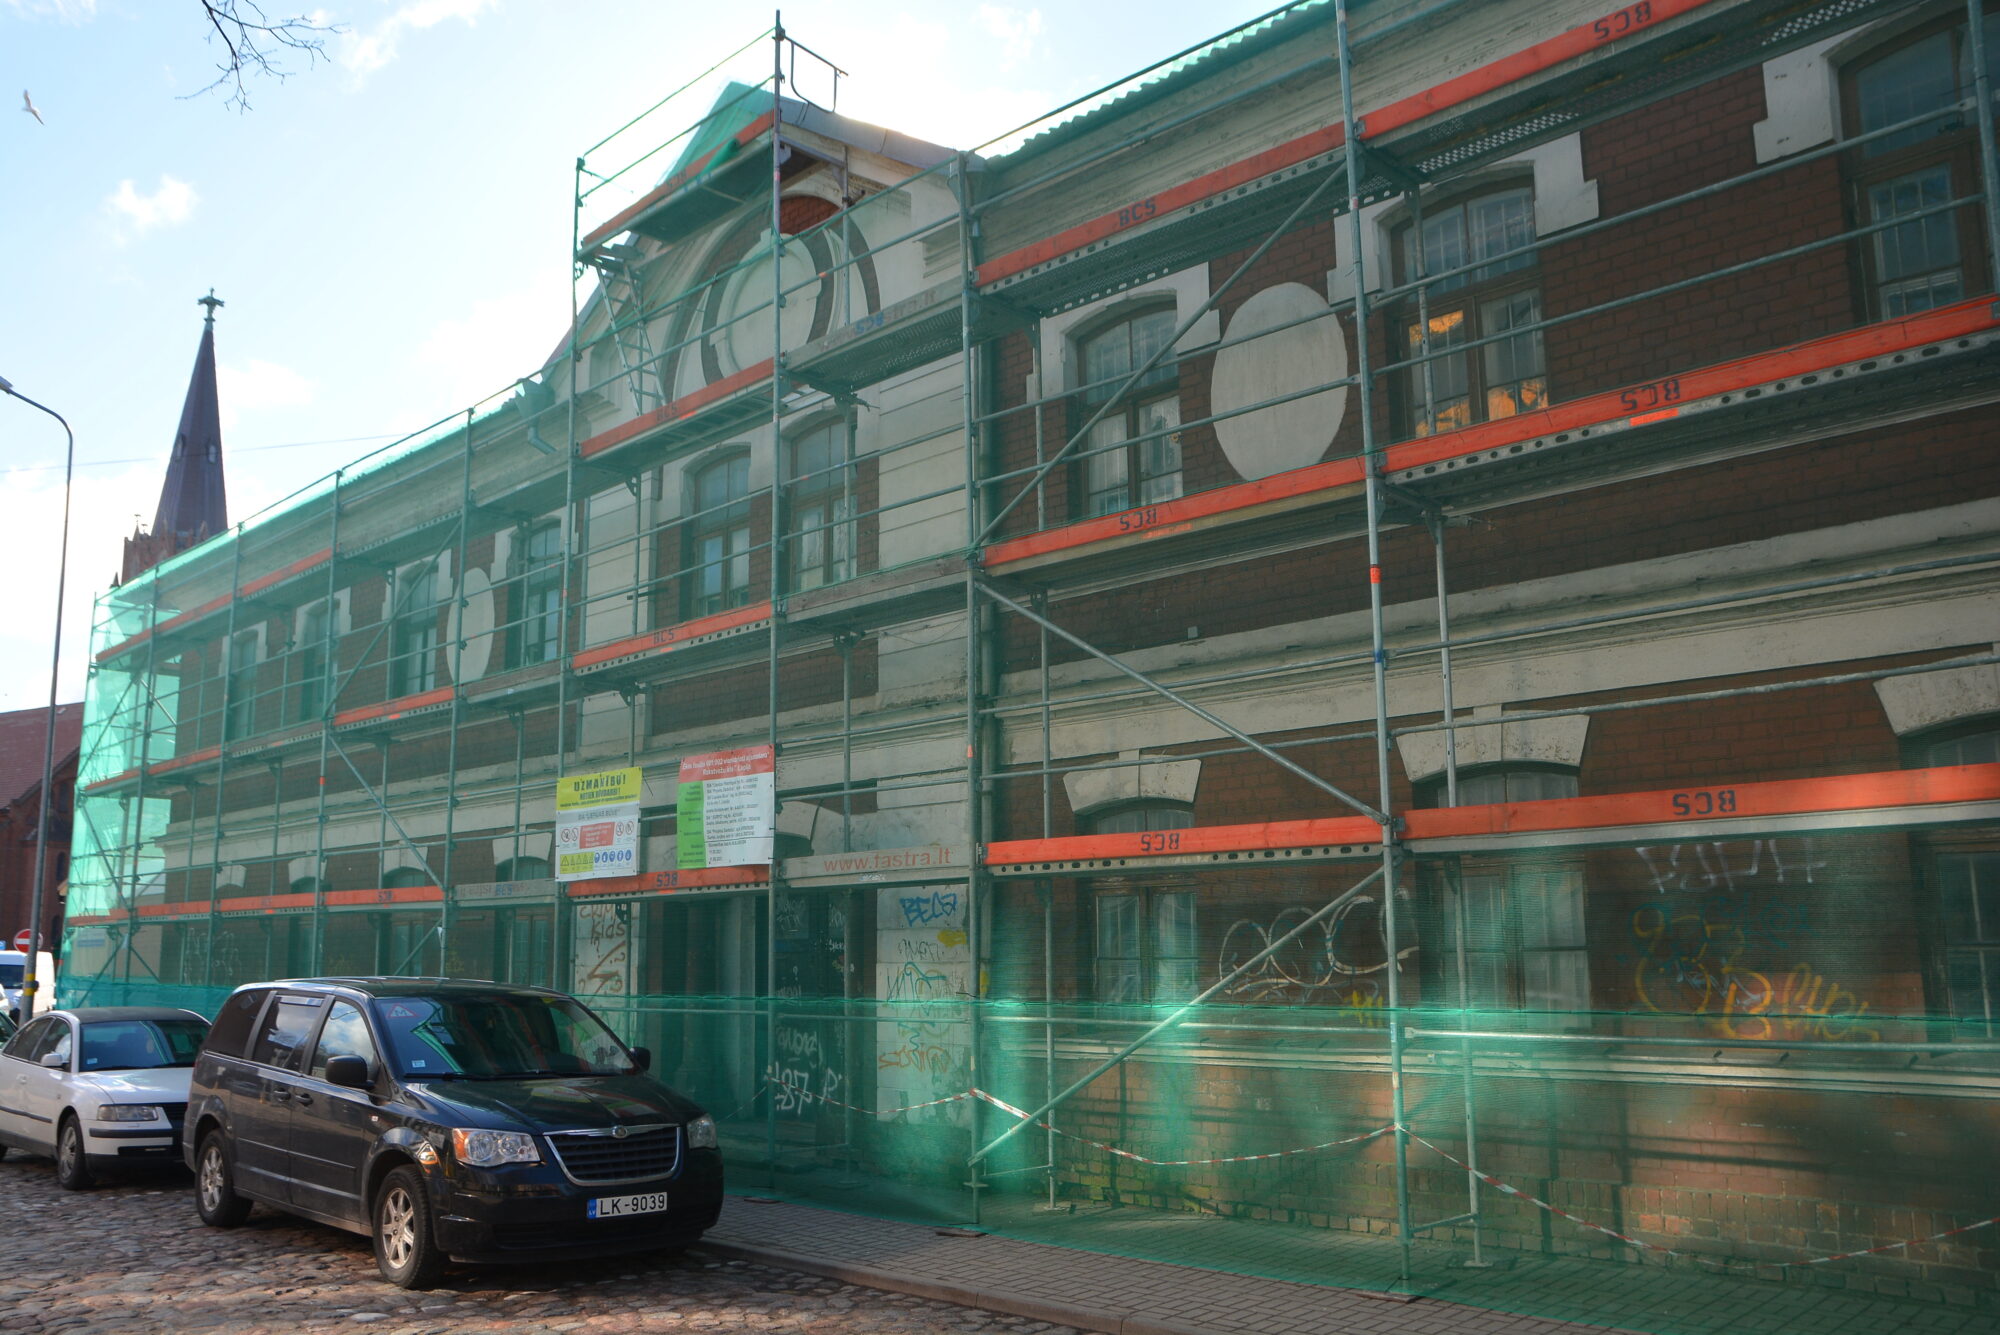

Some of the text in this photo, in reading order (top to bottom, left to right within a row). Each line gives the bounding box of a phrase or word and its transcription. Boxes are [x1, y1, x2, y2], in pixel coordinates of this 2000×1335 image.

[1594, 2, 1651, 40] BCS
[1119, 196, 1156, 226] BCS
[1621, 379, 1680, 411] BCS
[1120, 508, 1157, 530] BCS
[1673, 789, 1737, 816] BCS
[1141, 832, 1180, 851] BCS
[655, 872, 678, 887] BCS
[600, 1194, 665, 1216] LK-9039
